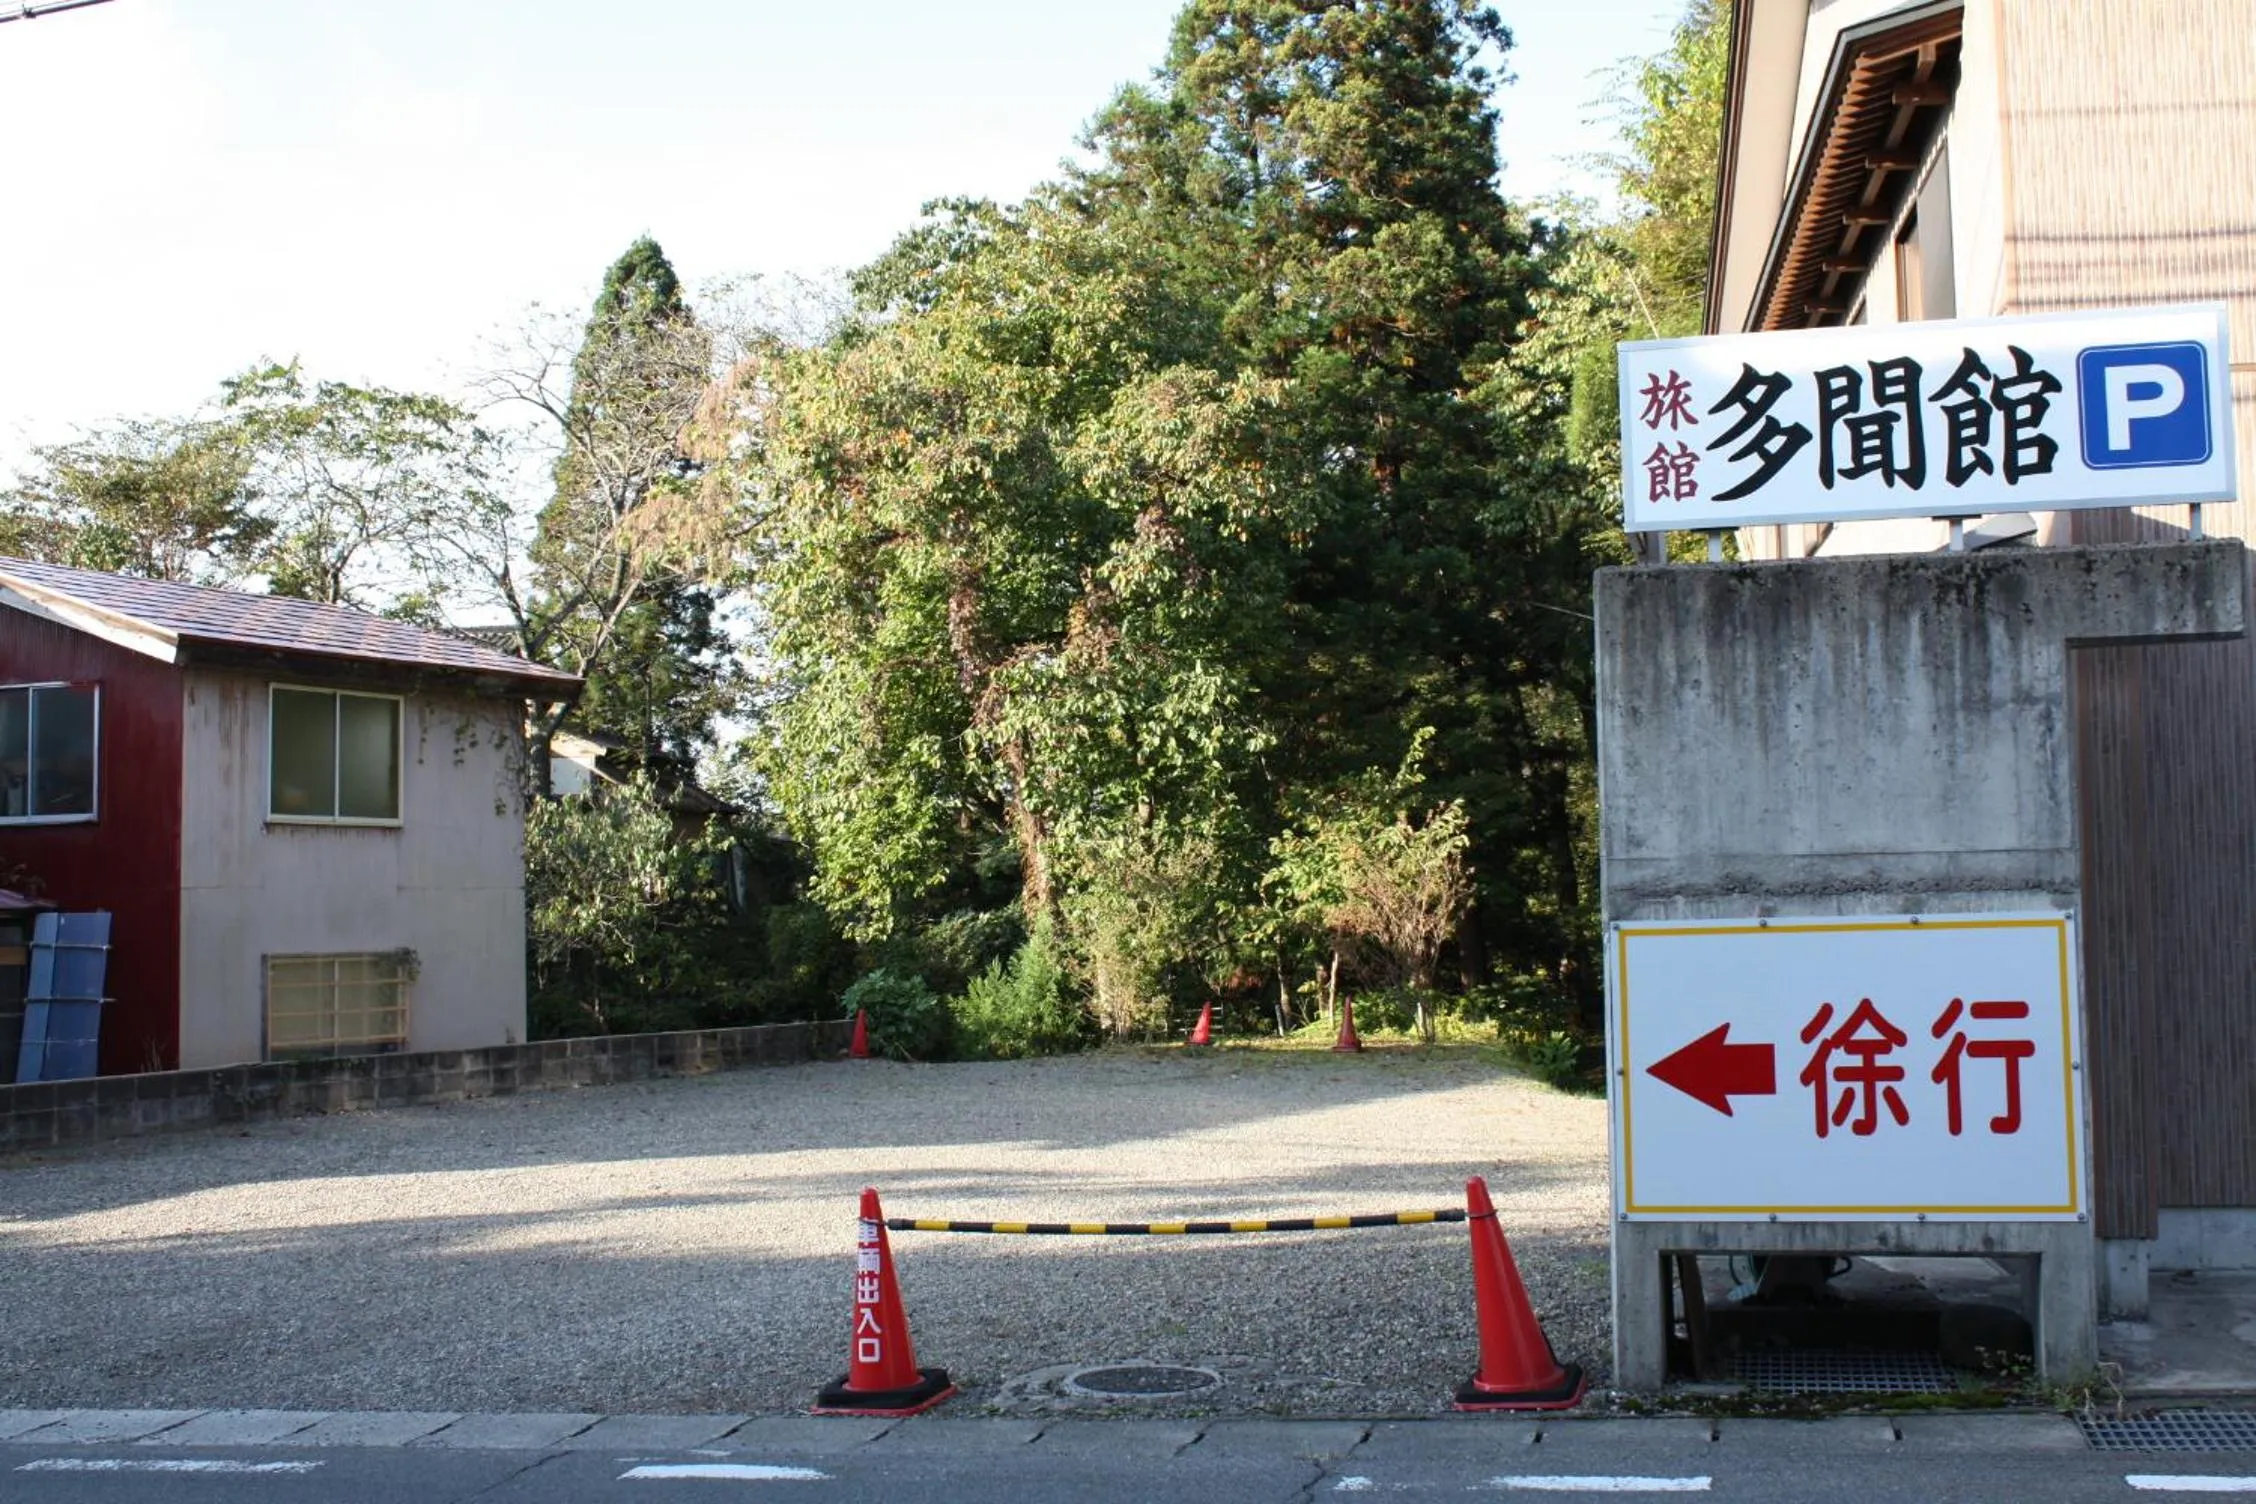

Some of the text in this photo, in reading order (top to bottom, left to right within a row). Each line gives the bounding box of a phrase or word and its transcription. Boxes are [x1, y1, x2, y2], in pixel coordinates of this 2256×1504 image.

[1639, 369, 1700, 502] 旅館
[1706, 345, 2063, 501] 多聞館
[2104, 363, 2184, 450] P
[1800, 998, 2036, 1137] 徐行
